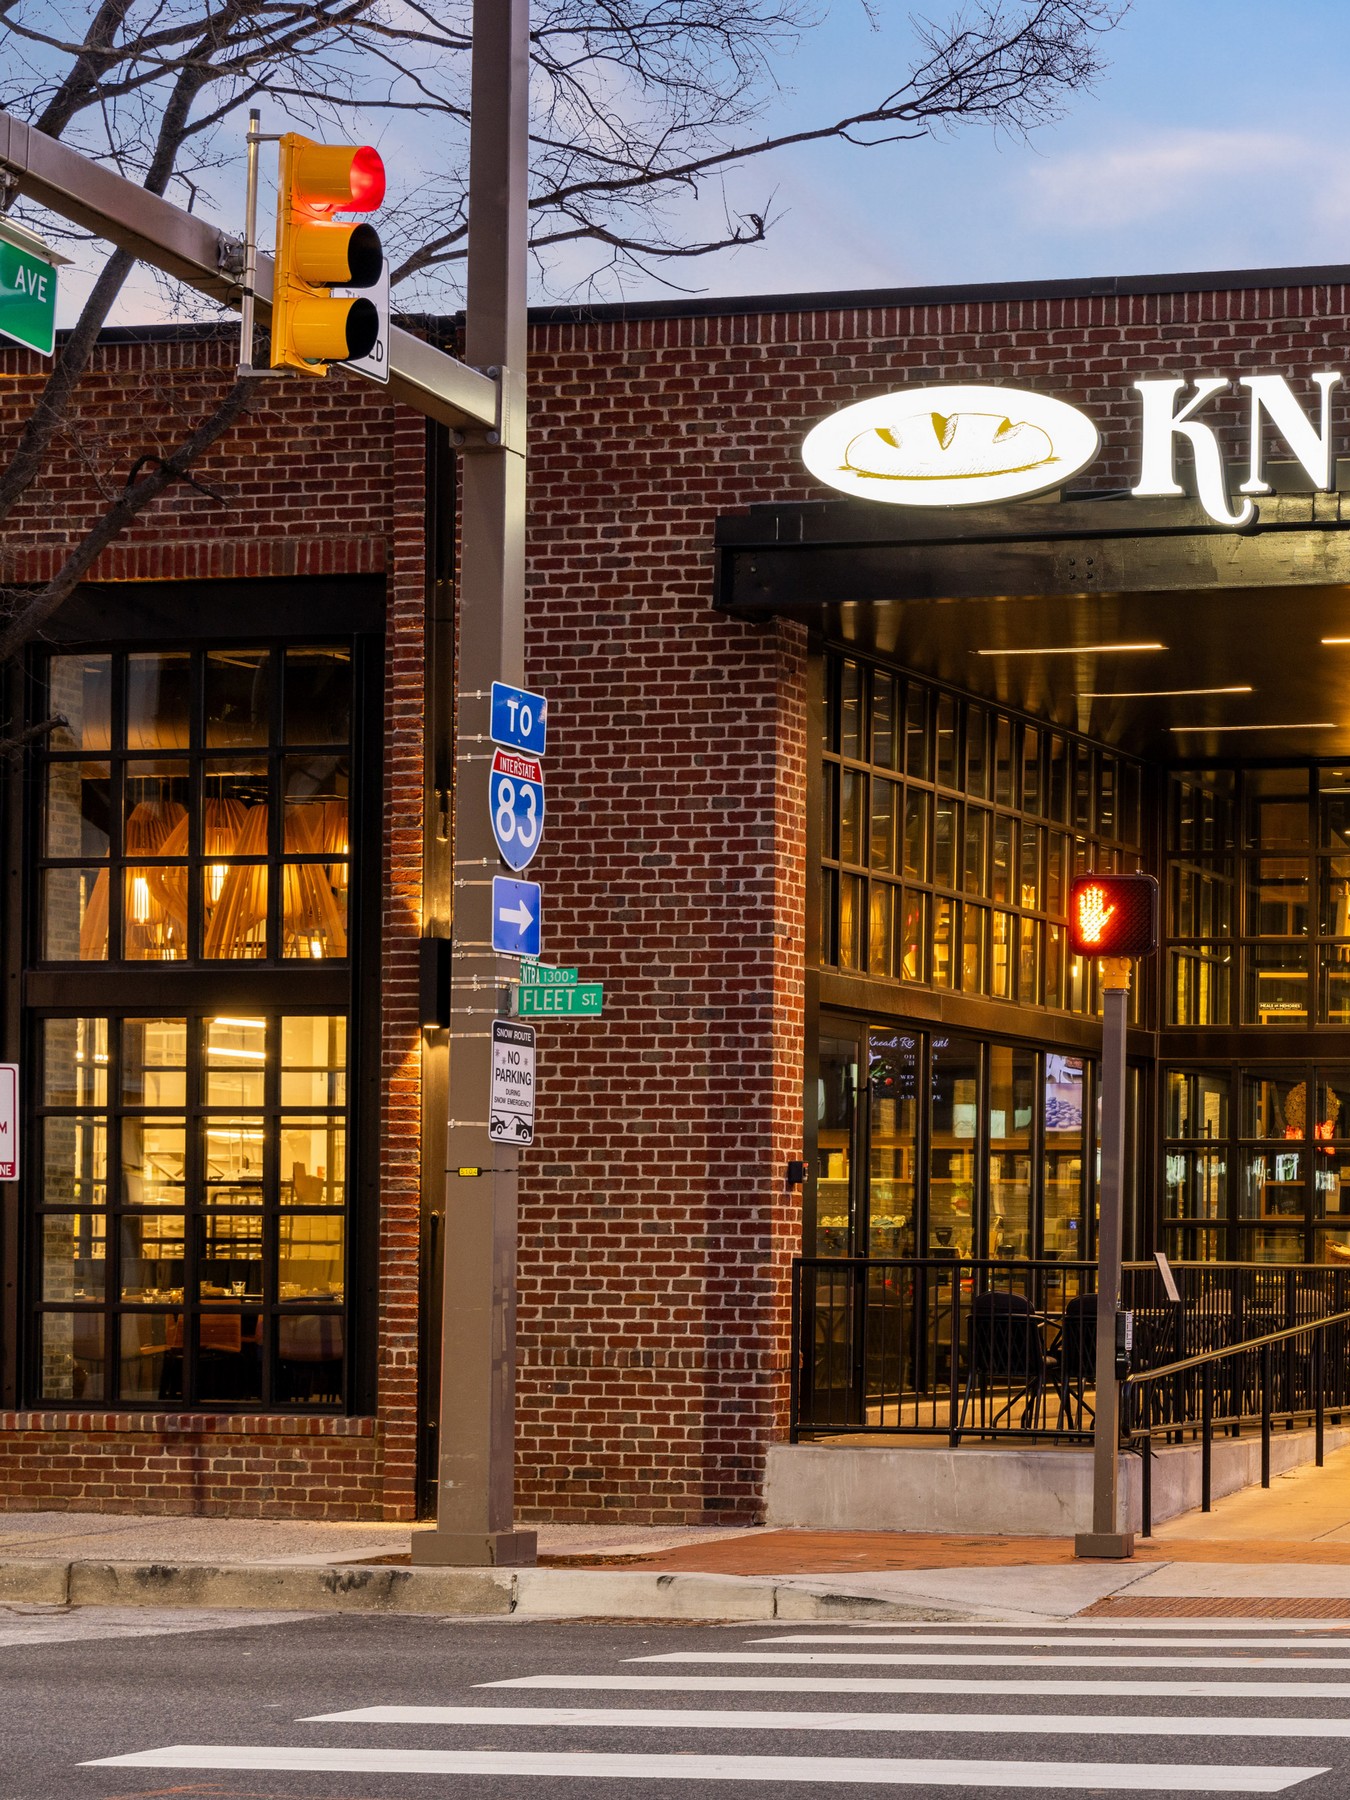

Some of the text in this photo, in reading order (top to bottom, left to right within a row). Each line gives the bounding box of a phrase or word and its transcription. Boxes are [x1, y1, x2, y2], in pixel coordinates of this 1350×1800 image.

[14, 264, 48, 303] AVE
[506, 699, 533, 737] TO
[499, 756, 536, 780] INTERSTATE
[496, 777, 537, 848] 83
[520, 964, 569, 984] NTRA 1300
[523, 989, 598, 1011] FLEET ST.
[496, 1027, 532, 1042] SNOW ROUTE
[507, 1050, 521, 1066] NO
[495, 1067, 532, 1086] PARKING
[494, 1096, 531, 1108] SNOW EMERGENCY
[505, 1088, 521, 1097] DURING
